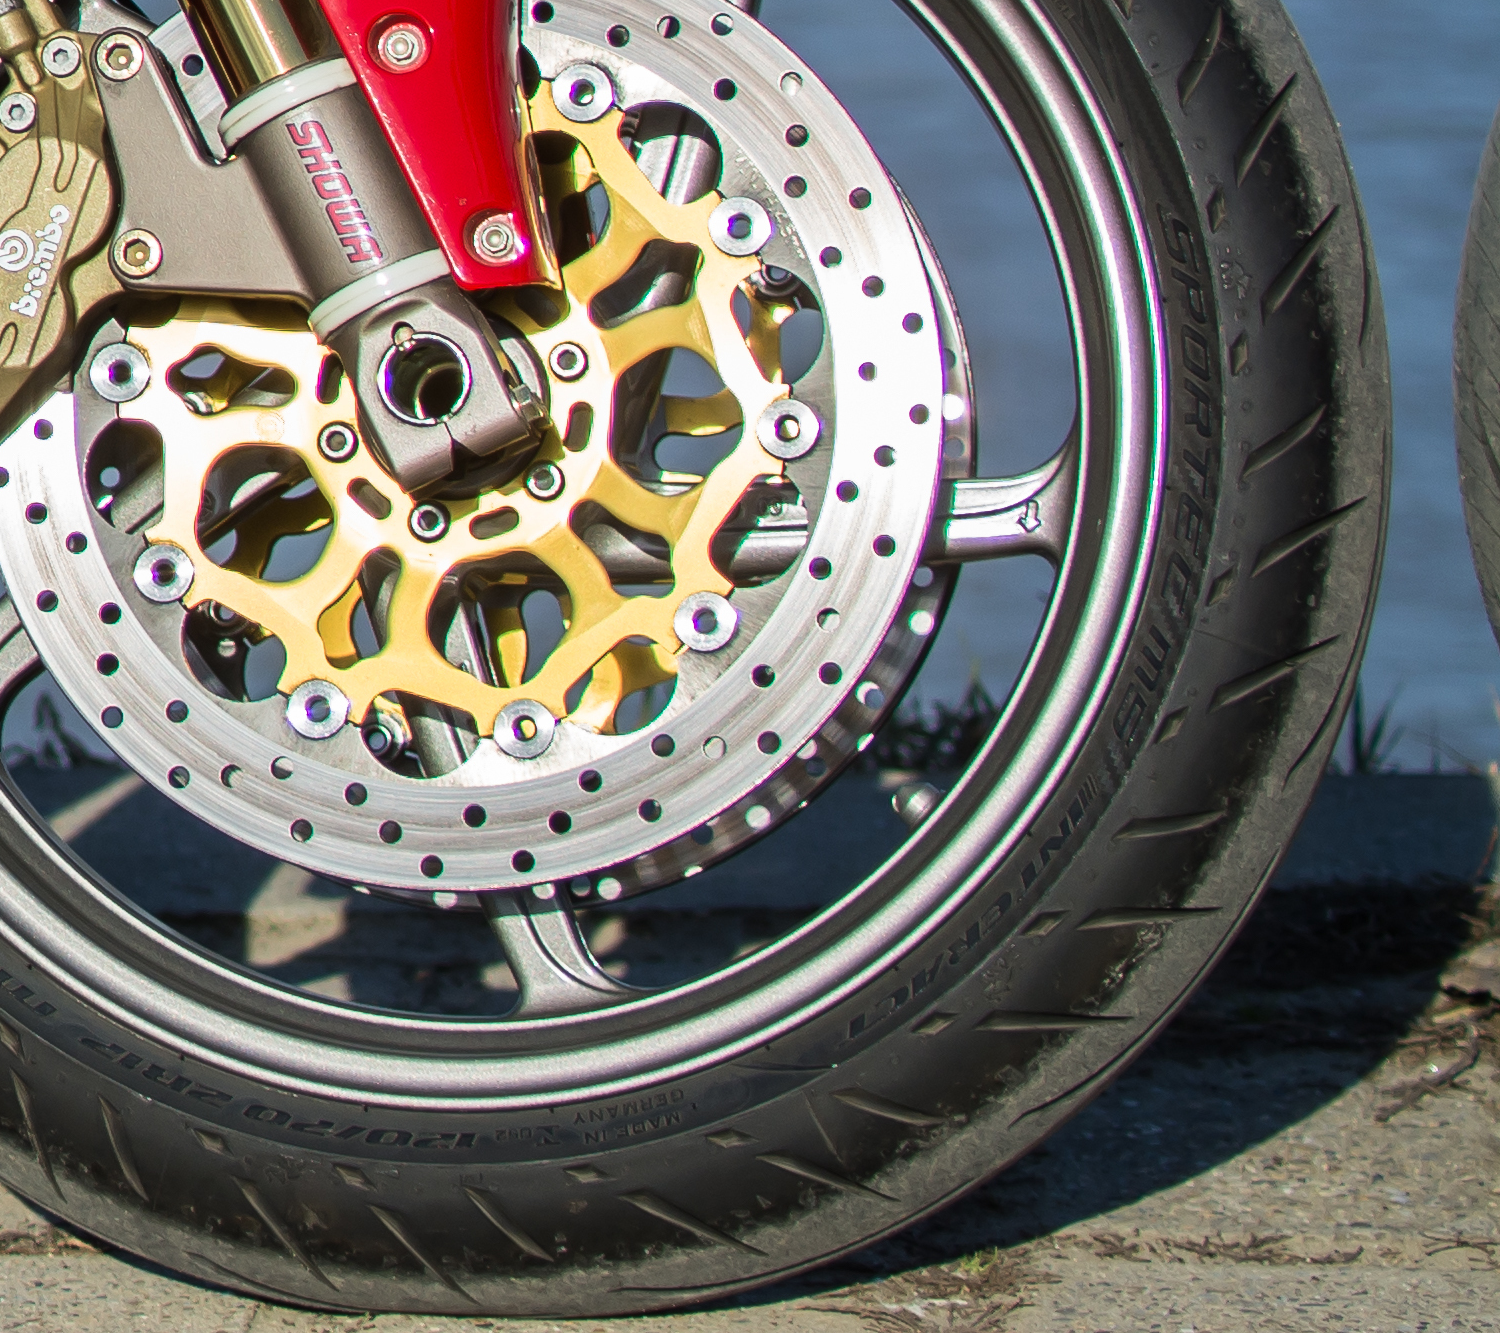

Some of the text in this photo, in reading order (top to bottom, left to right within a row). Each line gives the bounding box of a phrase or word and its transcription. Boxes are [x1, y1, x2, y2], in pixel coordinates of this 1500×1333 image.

[285, 119, 383, 265] SHOWA
[10, 205, 70, 318] brembo
[1152, 195, 1212, 618] SPORTEC
[76, 1024, 234, 1114] ZR17
[570, 1086, 686, 1126] GERMANY
[240, 1098, 478, 1151] 120/70
[583, 1110, 681, 1145] MADE IN
